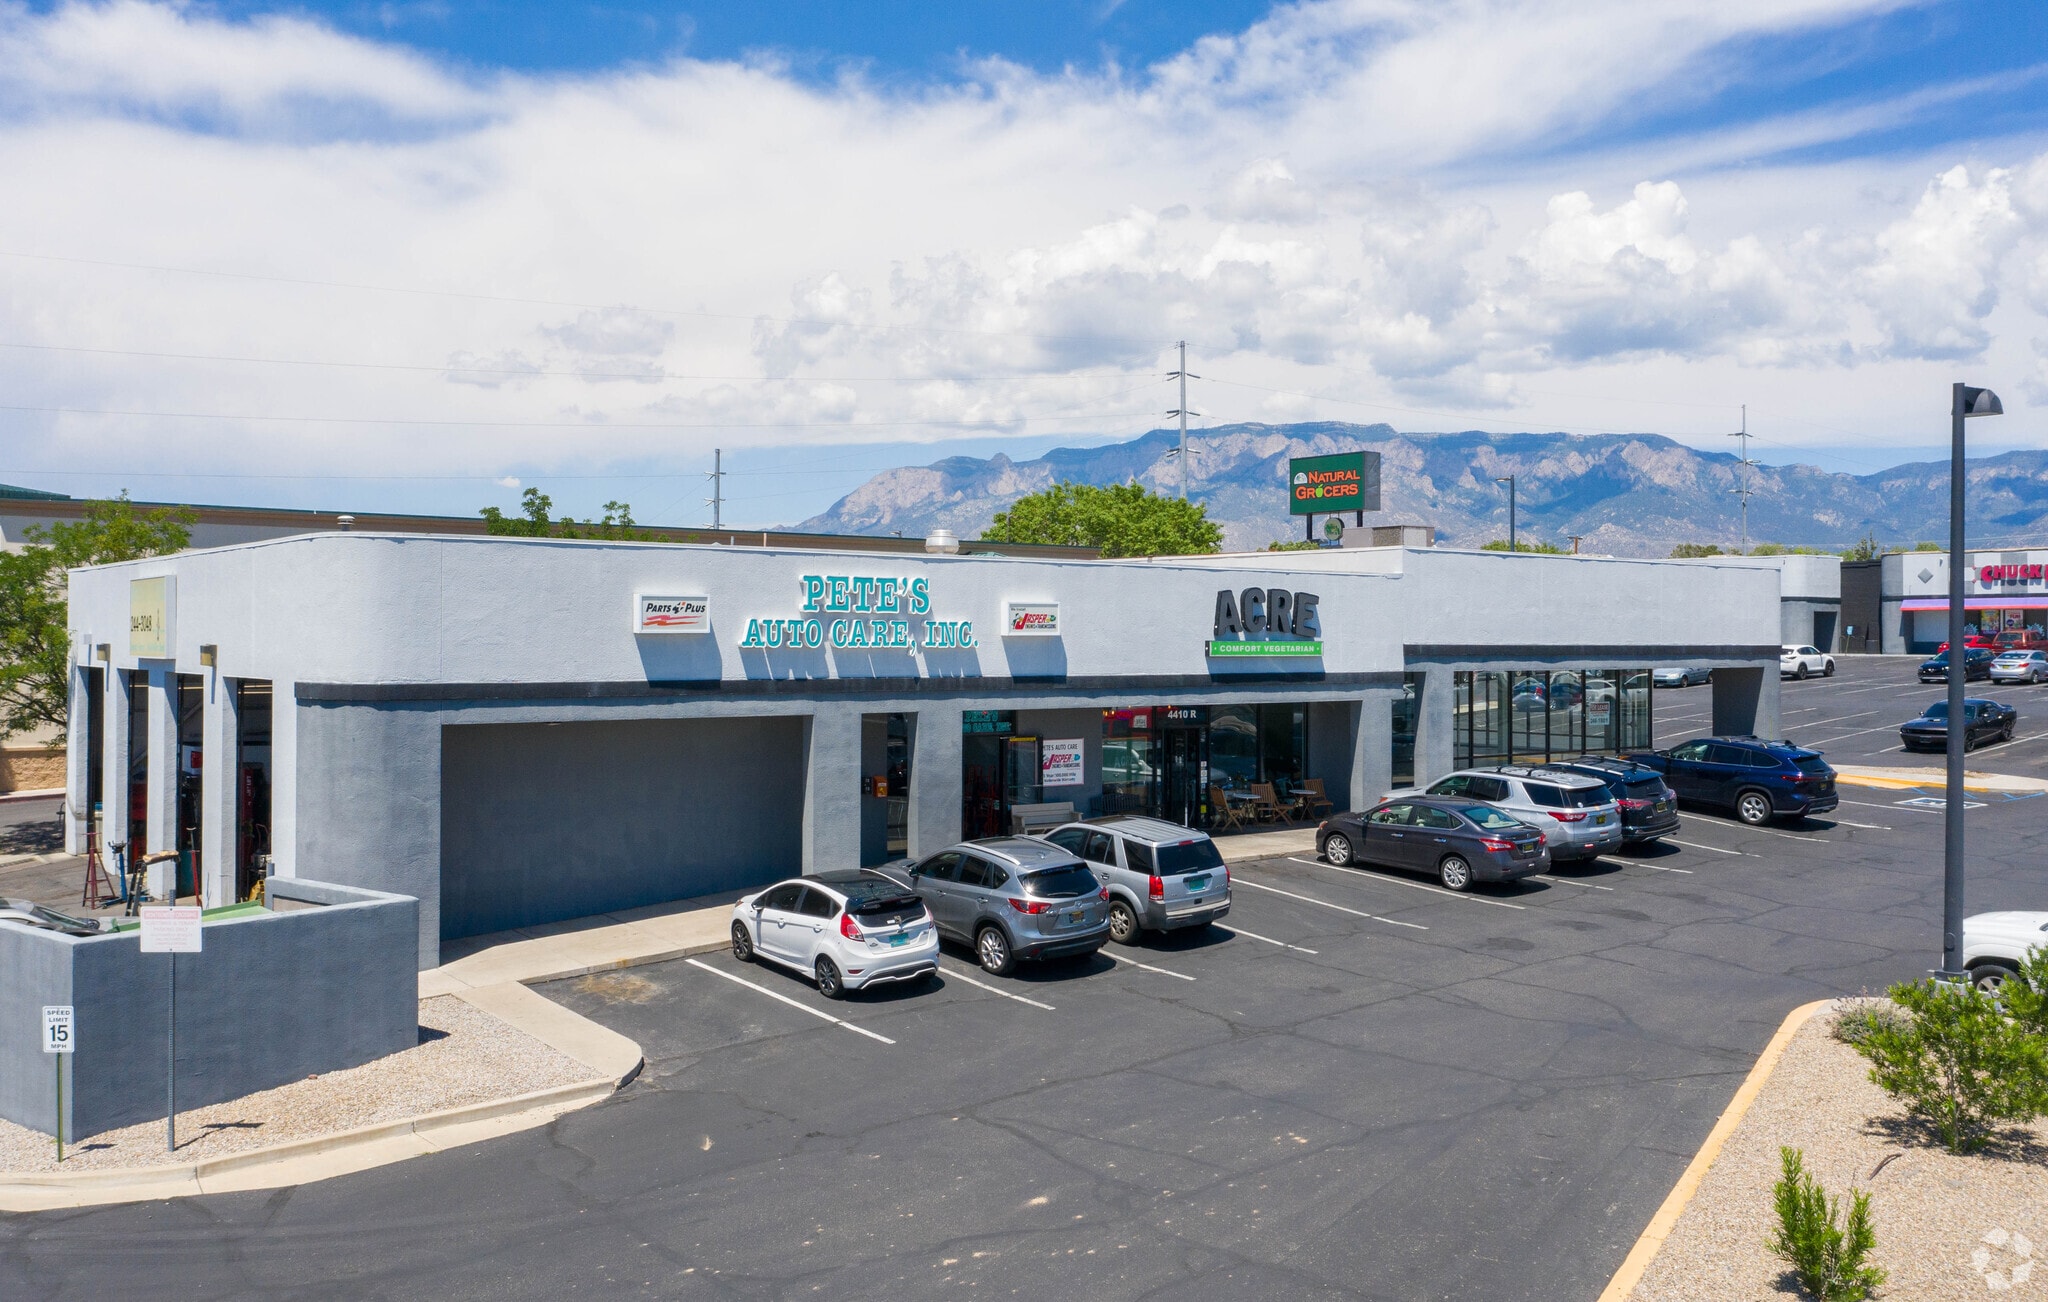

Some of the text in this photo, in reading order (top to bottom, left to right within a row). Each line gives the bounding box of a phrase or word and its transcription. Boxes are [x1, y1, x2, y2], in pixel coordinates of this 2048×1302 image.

[1308, 469, 1360, 484] NATURAL
[1296, 483, 1359, 499] GROCERS
[1981, 564, 2042, 583] CHUCK
[801, 575, 932, 614] PETE'S
[646, 603, 706, 613] PARTS PLUS
[1214, 587, 1319, 637] ACRE
[1015, 613, 1048, 630] JASPER
[740, 618, 979, 657] AUTO CARE, INC.
[1167, 709, 1197, 719] 4410 R
[50, 1024, 68, 1042] 15
